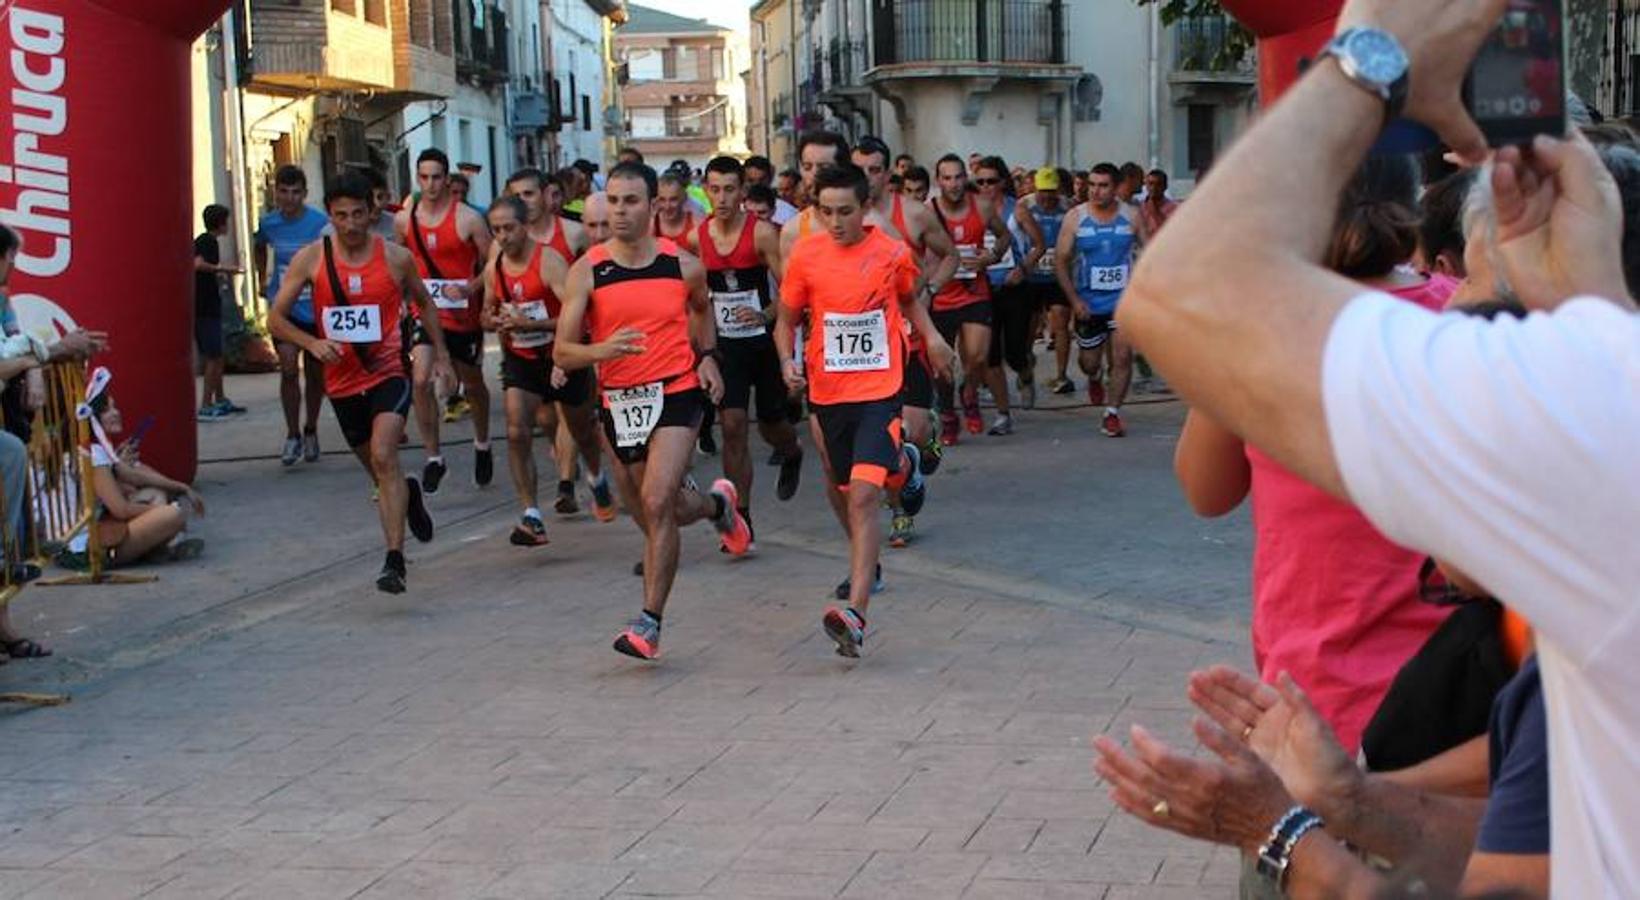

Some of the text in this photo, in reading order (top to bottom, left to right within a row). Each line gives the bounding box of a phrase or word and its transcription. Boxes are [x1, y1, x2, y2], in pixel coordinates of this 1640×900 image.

[0, 7, 71, 277] Chiruca
[1099, 268, 1122, 283] 256
[331, 308, 370, 331] 254
[824, 318, 878, 328] EL CORREO
[835, 332, 873, 354] 176
[839, 356, 881, 366] CORREO
[622, 404, 653, 428] 137
[628, 430, 648, 440] CORR
